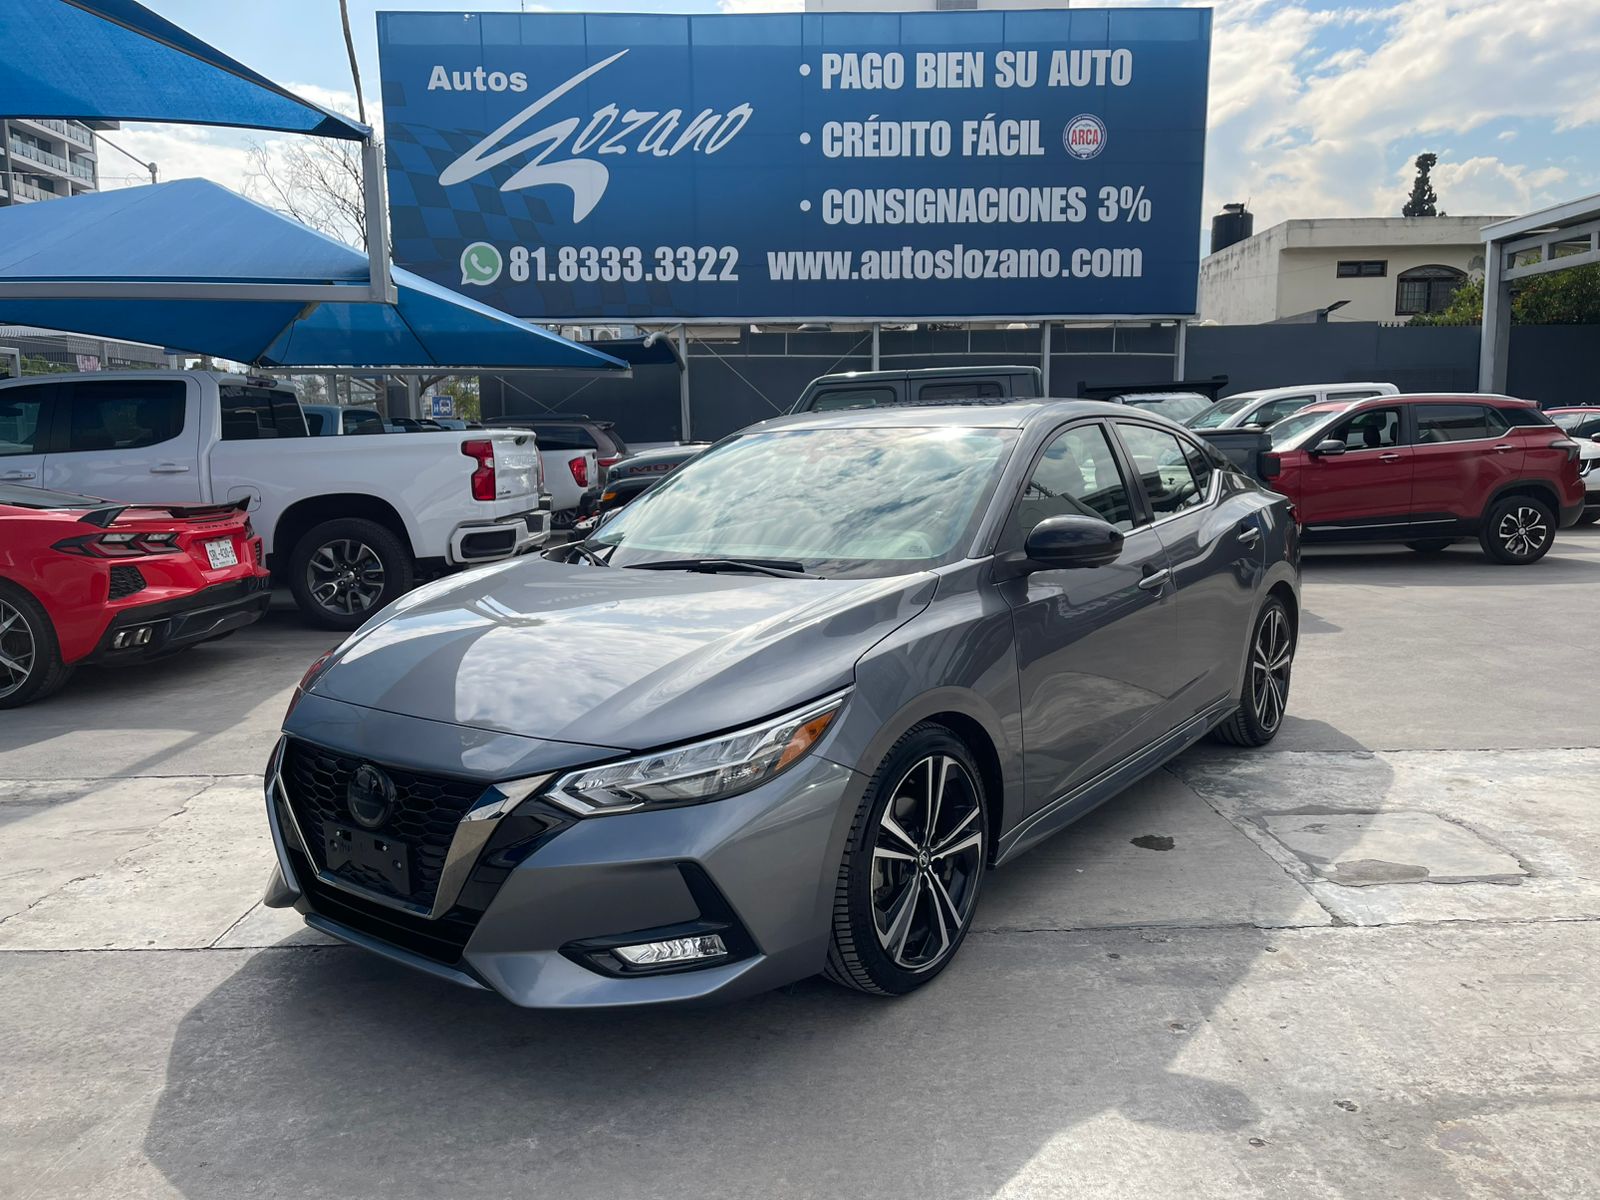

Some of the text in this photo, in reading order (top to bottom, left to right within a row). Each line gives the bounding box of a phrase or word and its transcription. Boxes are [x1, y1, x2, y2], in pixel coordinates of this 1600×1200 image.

[427, 65, 529, 93] Autos
[821, 48, 1134, 90] PAGO BIEN SU AUTO
[822, 112, 1045, 158] CRÉDITO FÁCIL
[1071, 128, 1099, 146] ARCA
[822, 185, 1152, 225] CONSIGNACIONES 3%
[509, 245, 740, 282] 81.8333.3322
[767, 244, 1144, 280] www.autoslozano.com
